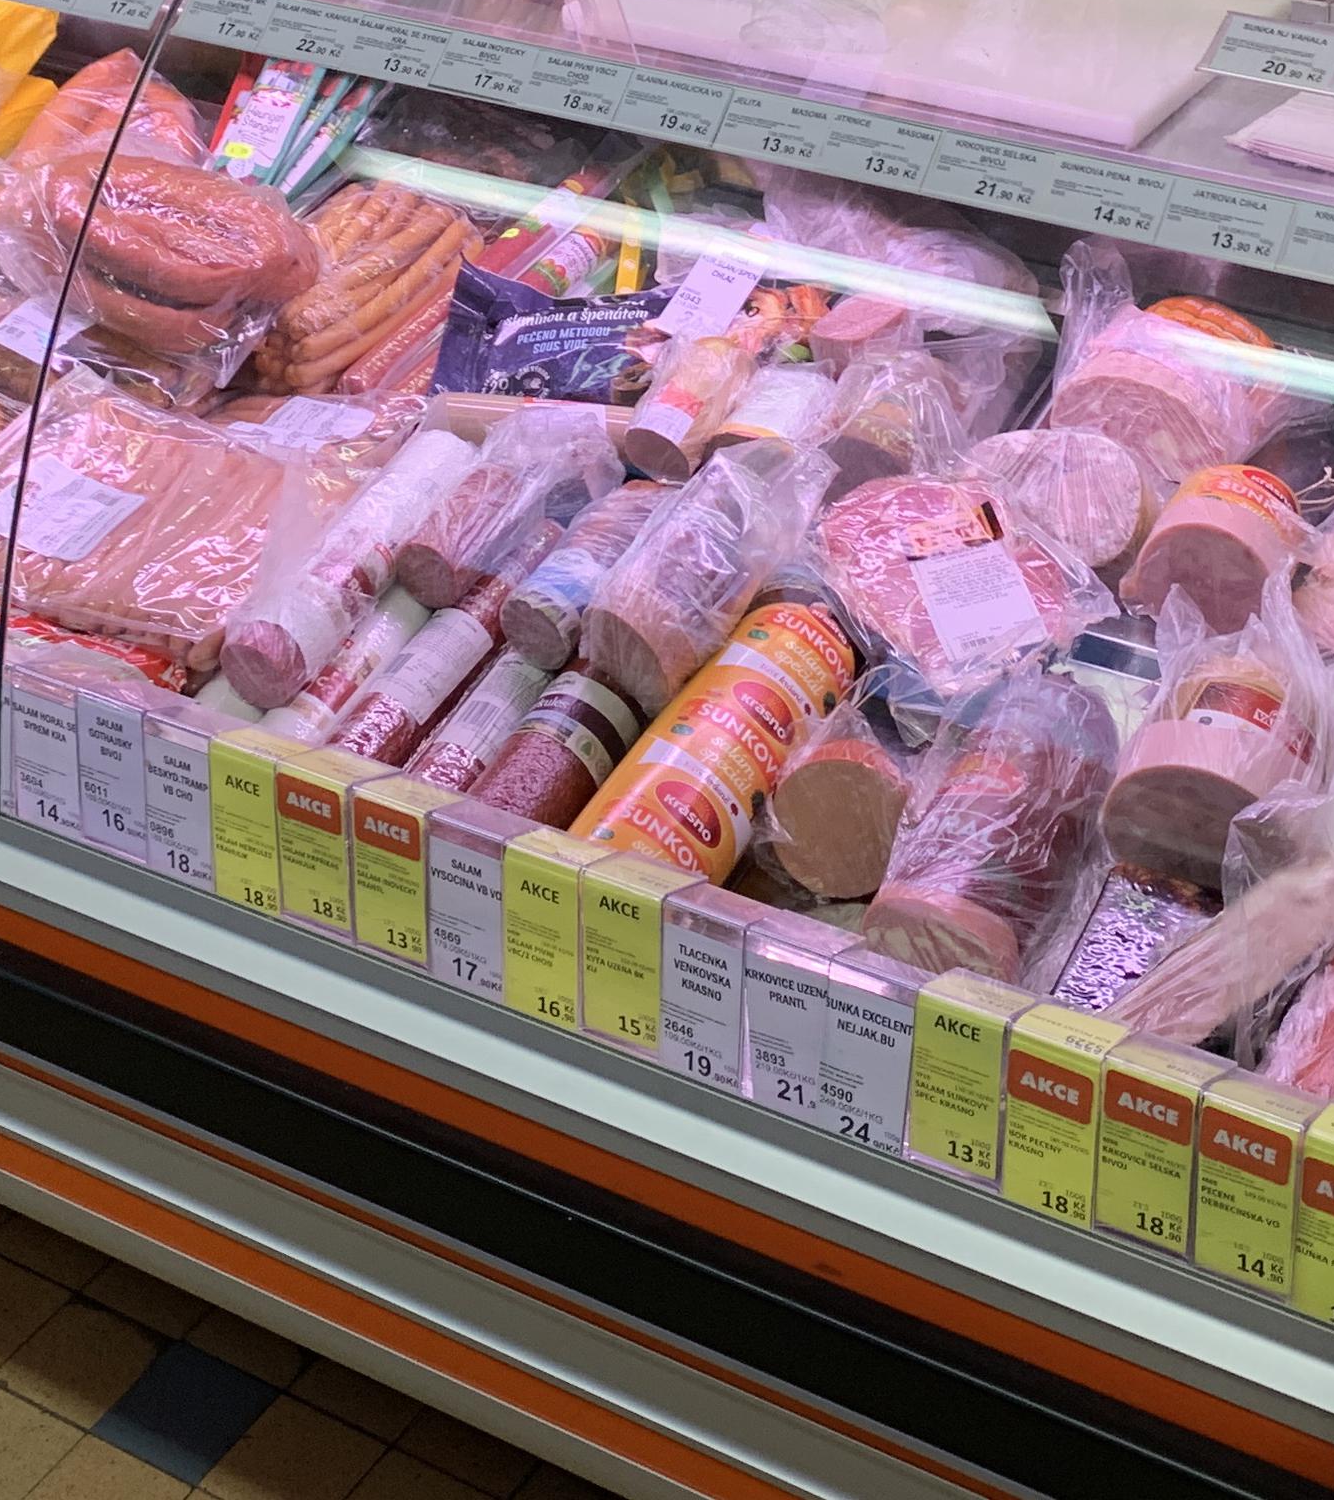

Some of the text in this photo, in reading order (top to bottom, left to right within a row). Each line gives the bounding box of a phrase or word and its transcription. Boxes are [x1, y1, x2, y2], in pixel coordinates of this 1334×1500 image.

[558, 326, 611, 339] METODOU
[532, 340, 561, 354] SOUS
[740, 692, 787, 740] krásno
[36, 799, 60, 823] 14
[286, 790, 332, 820] AKCE
[663, 792, 712, 842] krásno
[101, 808, 125, 832] 16
[363, 815, 411, 845] AKCE
[167, 850, 190, 874] 18
[520, 879, 560, 905] AKCE
[599, 895, 640, 921] AKCE
[386, 928, 409, 950] 13
[678, 943, 729, 972] TLACENKA
[674, 959, 732, 990] VENKOVSKA
[744, 967, 829, 1001] KRKOVICE UZENA
[681, 978, 723, 1003] KRASNO
[768, 990, 808, 1012] PRANTL
[536, 996, 560, 1018] 16
[618, 1015, 641, 1037] 15
[664, 1018, 695, 1039] 2646
[862, 1006, 915, 1037] EXCELENT
[934, 1014, 981, 1043] AKCE
[683, 1050, 712, 1077] 19
[776, 1079, 805, 1105] 21
[820, 1082, 853, 1104] 4590
[1019, 1070, 1080, 1106] AKCE
[1117, 1091, 1179, 1127] AKCE
[839, 1115, 870, 1143] 24
[947, 1139, 973, 1164] 13
[1213, 1128, 1277, 1166] AKCE
[1040, 1190, 1069, 1214] 18
[1135, 1213, 1164, 1236] 18
[1236, 1253, 1266, 1278] 14
